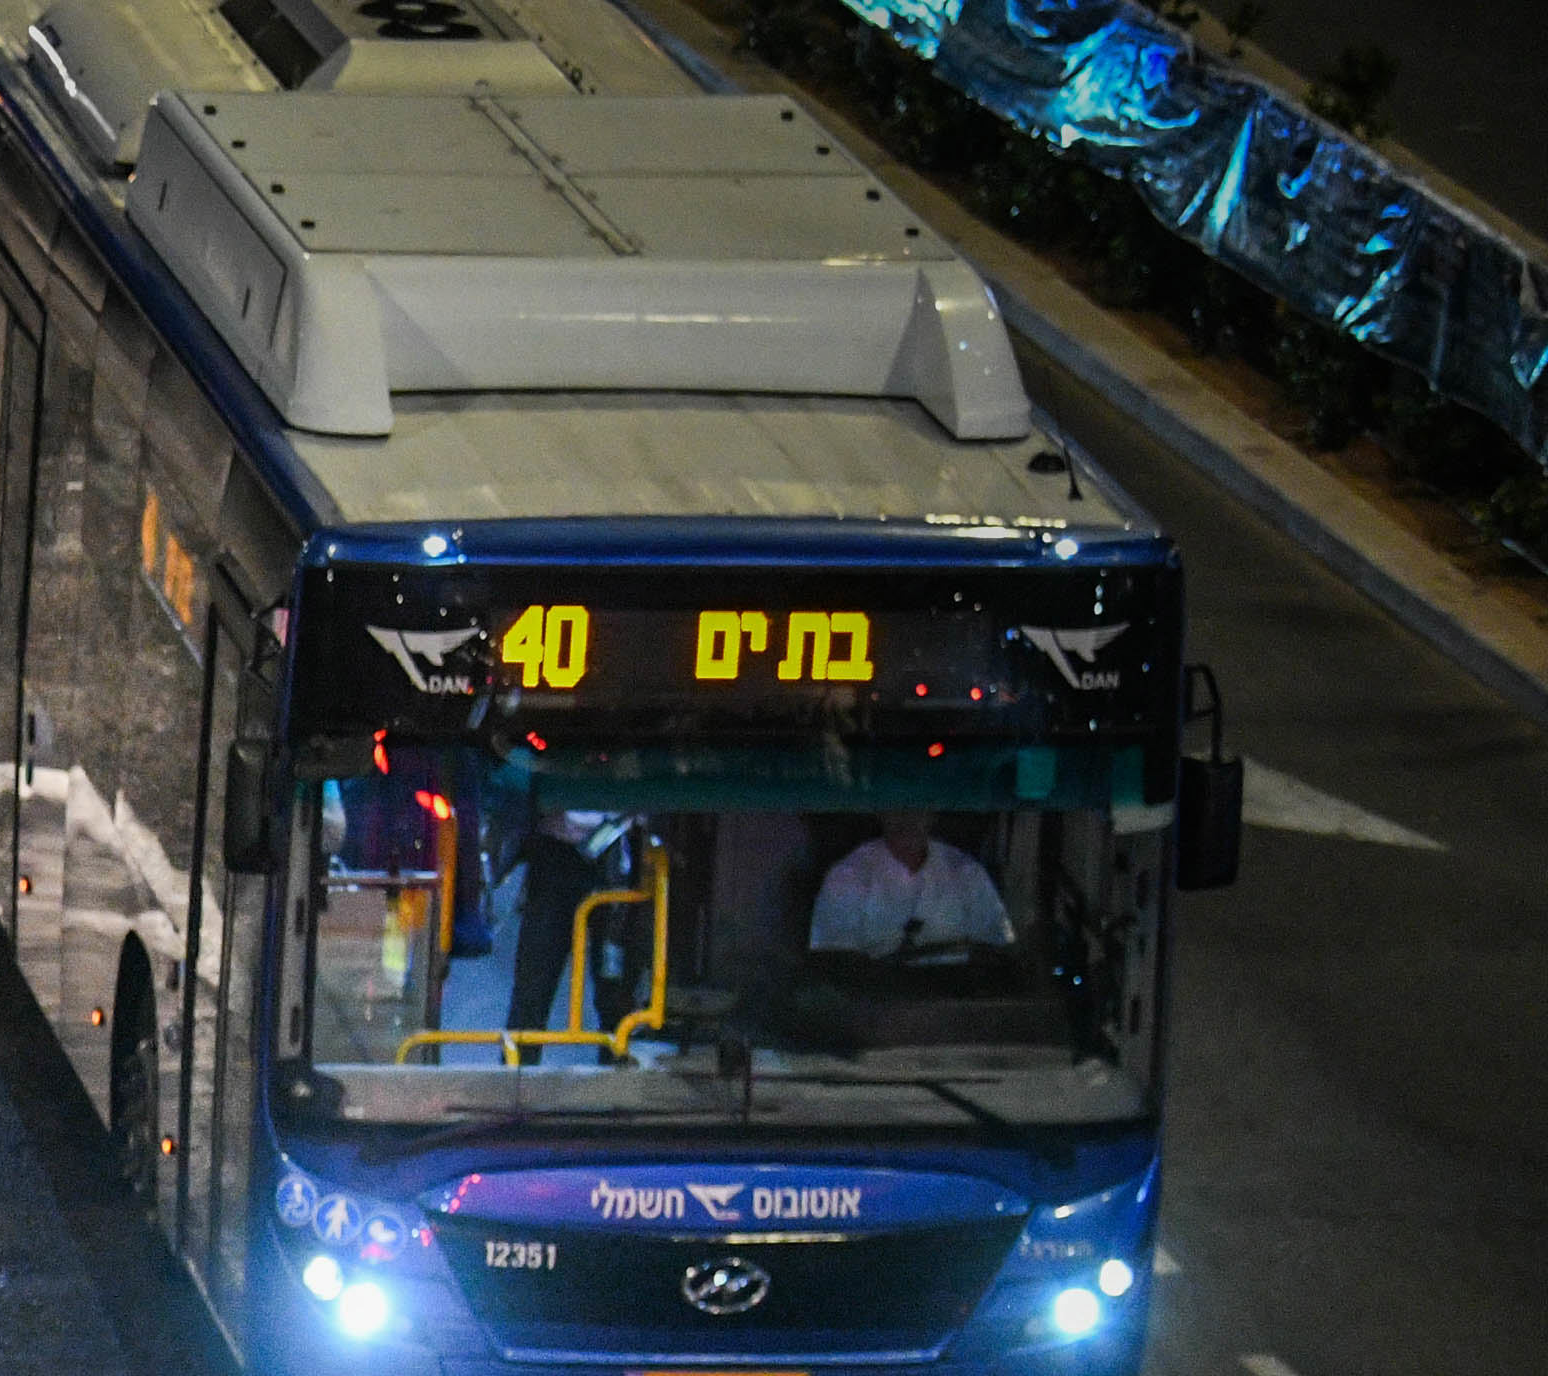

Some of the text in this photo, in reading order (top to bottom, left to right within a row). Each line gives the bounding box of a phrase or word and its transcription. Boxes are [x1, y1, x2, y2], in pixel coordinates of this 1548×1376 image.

[502, 604, 589, 688] 40
[695, 611, 873, 682] בת ים
[591, 1180, 862, 1220] אוטובוס חשמלי
[485, 1241, 556, 1271] 12351
